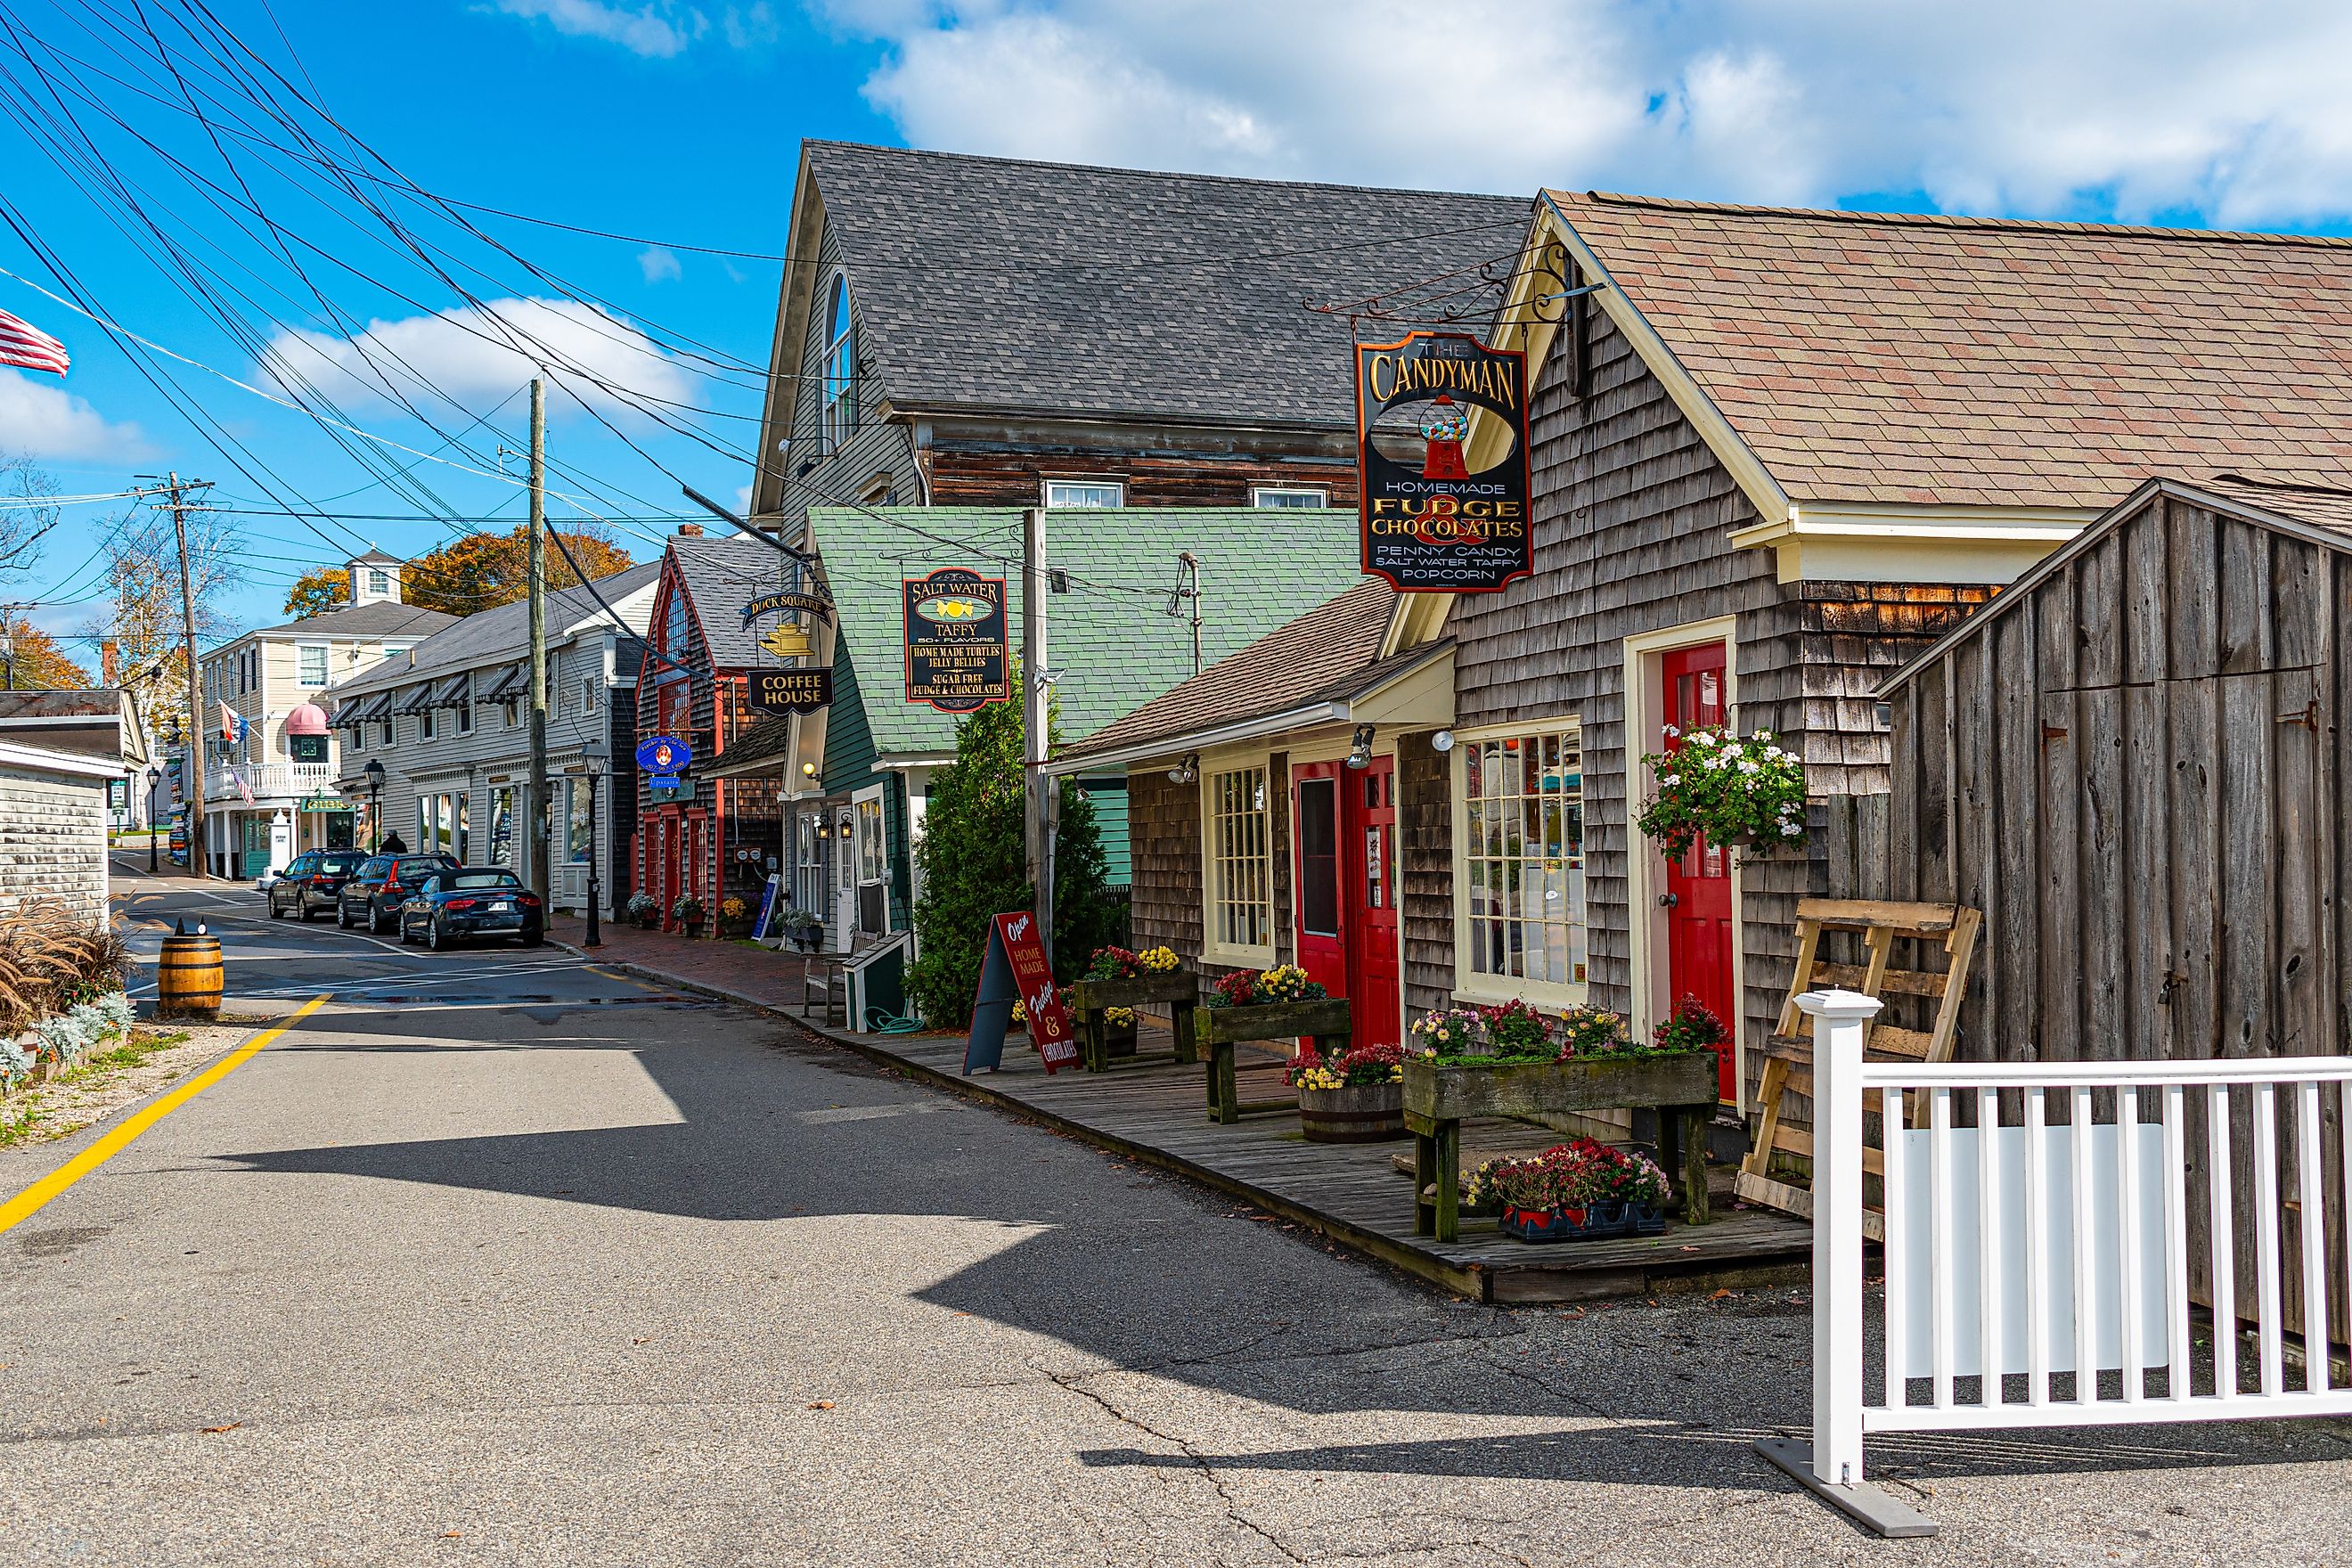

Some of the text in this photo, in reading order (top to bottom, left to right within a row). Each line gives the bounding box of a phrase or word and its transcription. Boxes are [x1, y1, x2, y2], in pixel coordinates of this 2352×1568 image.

[1417, 342, 1468, 356] THE
[1369, 355, 1515, 410] CANDYMAN
[1386, 481, 1506, 494] HOMEMADE
[1373, 498, 1521, 518] FUDGE
[1371, 518, 1523, 538] CHOCOLATES
[1377, 545, 1522, 557] PENNY CANDY
[1376, 557, 1522, 568] SALT WATER TAFFY
[1402, 568, 1496, 580] POPCORN
[912, 583, 999, 603] SALT WATER
[751, 595, 822, 615] DOCK SQUARE
[935, 624, 977, 637] TAFFY
[913, 646, 1000, 657] HOME MADE TURTLES
[928, 657, 986, 667] JELLY BELLIES
[762, 675, 821, 690] COFFEE
[932, 674, 984, 684] SUGAR FREE
[913, 683, 1002, 695] FUDGE & CHOCOLATES
[764, 690, 821, 705] HOUSE
[1007, 914, 1029, 942] Open
[1014, 947, 1041, 962] HOME
[1020, 960, 1045, 976] MADE
[1030, 980, 1053, 1023] Fudge
[1045, 1016, 1059, 1037] &
[1042, 1039, 1077, 1063] CHOCOLATES
